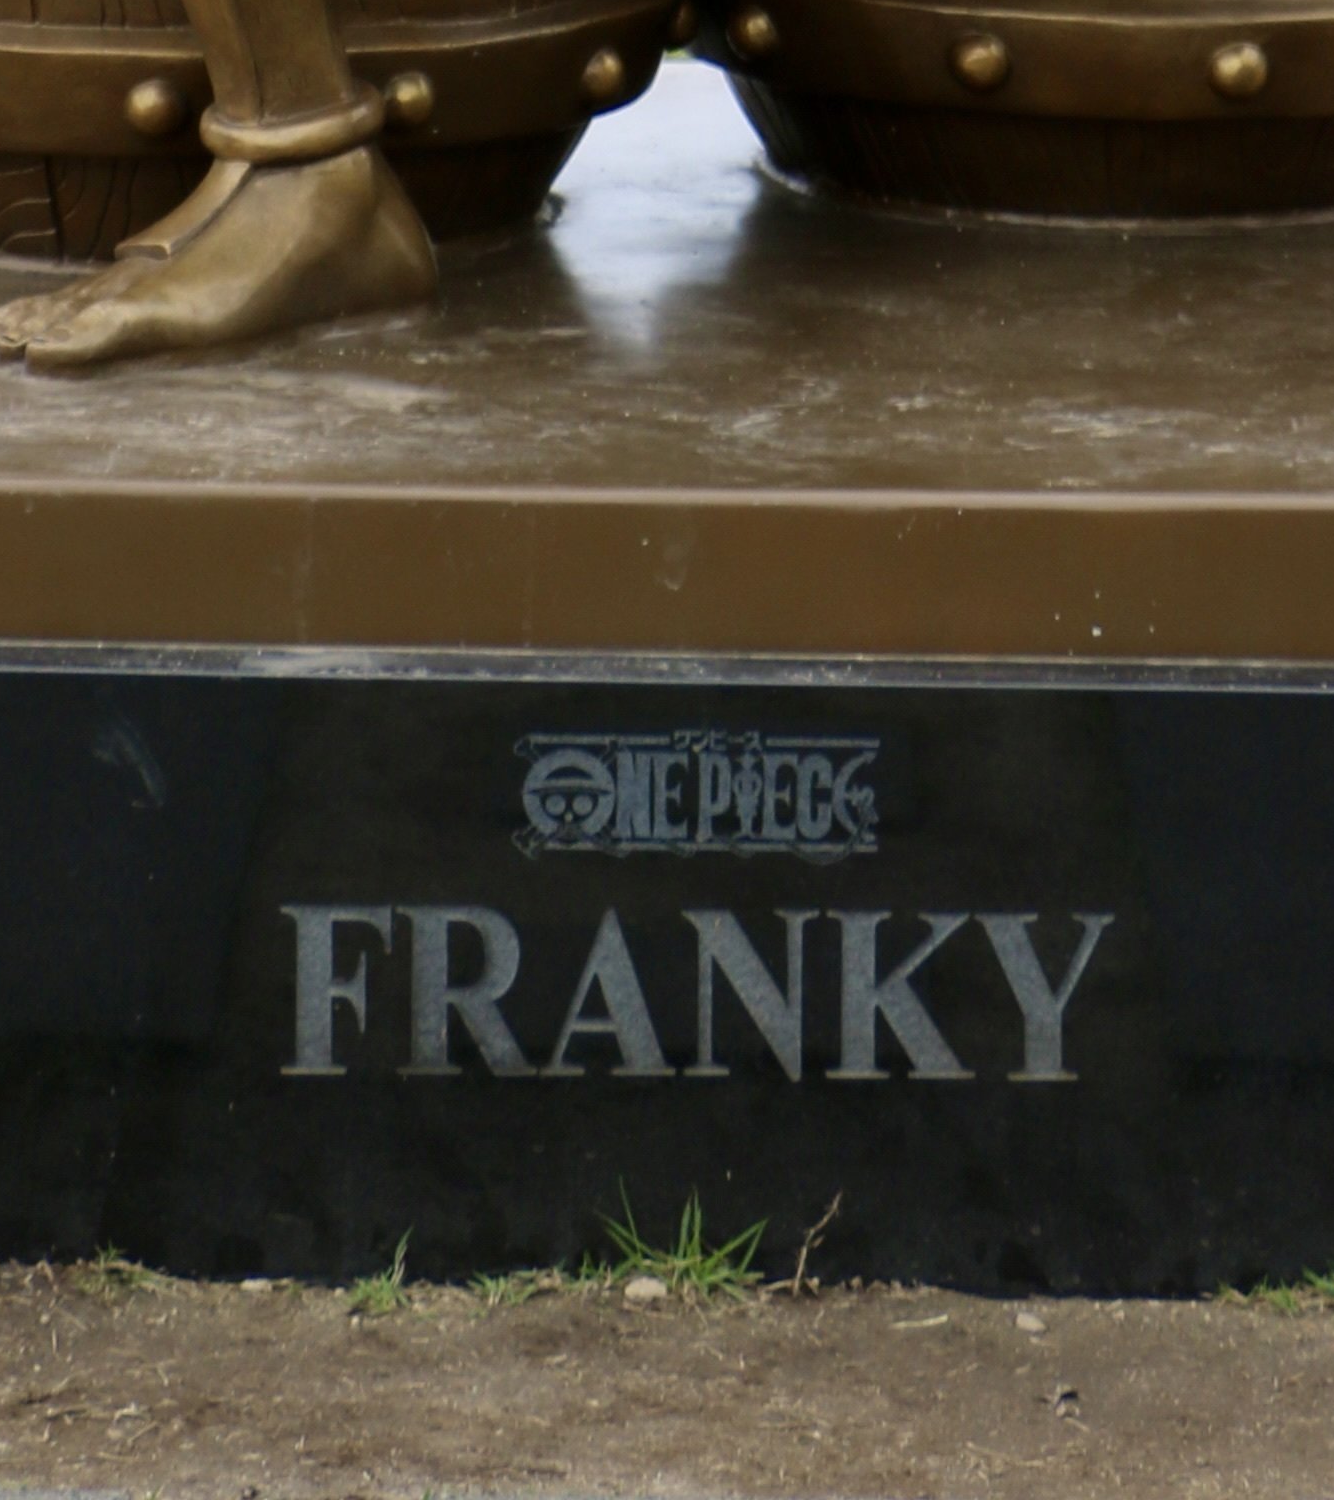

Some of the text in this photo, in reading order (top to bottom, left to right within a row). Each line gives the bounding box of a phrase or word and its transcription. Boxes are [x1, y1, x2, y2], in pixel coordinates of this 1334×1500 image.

[522, 748, 880, 845] ONE PIECE
[280, 904, 1116, 1083] FRANKY
